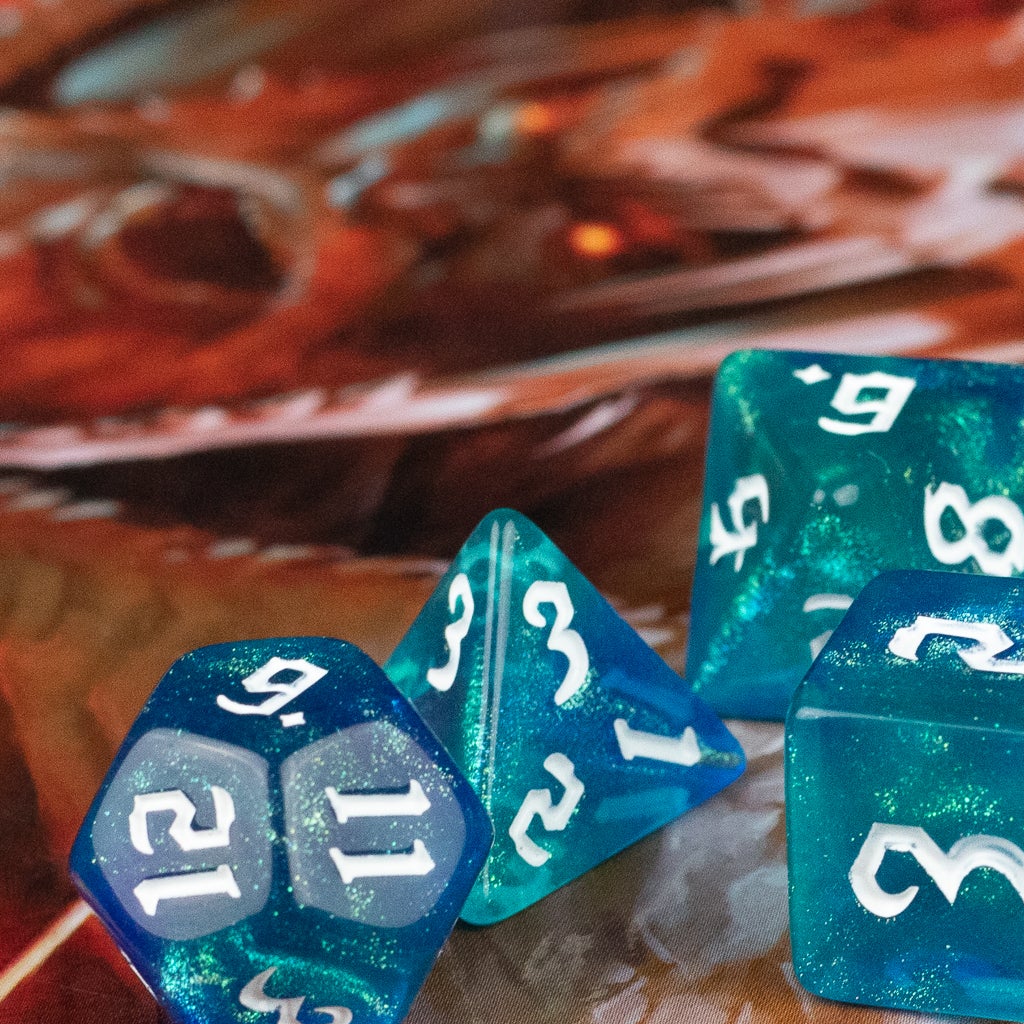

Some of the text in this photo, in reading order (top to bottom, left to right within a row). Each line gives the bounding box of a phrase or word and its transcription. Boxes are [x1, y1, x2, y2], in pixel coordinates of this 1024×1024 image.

[427, 574, 474, 691] 3
[523, 581, 590, 705] 3
[614, 719, 701, 766] 1
[127, 777, 241, 917] 12
[326, 779, 437, 885] 11
[509, 753, 584, 866] 2
